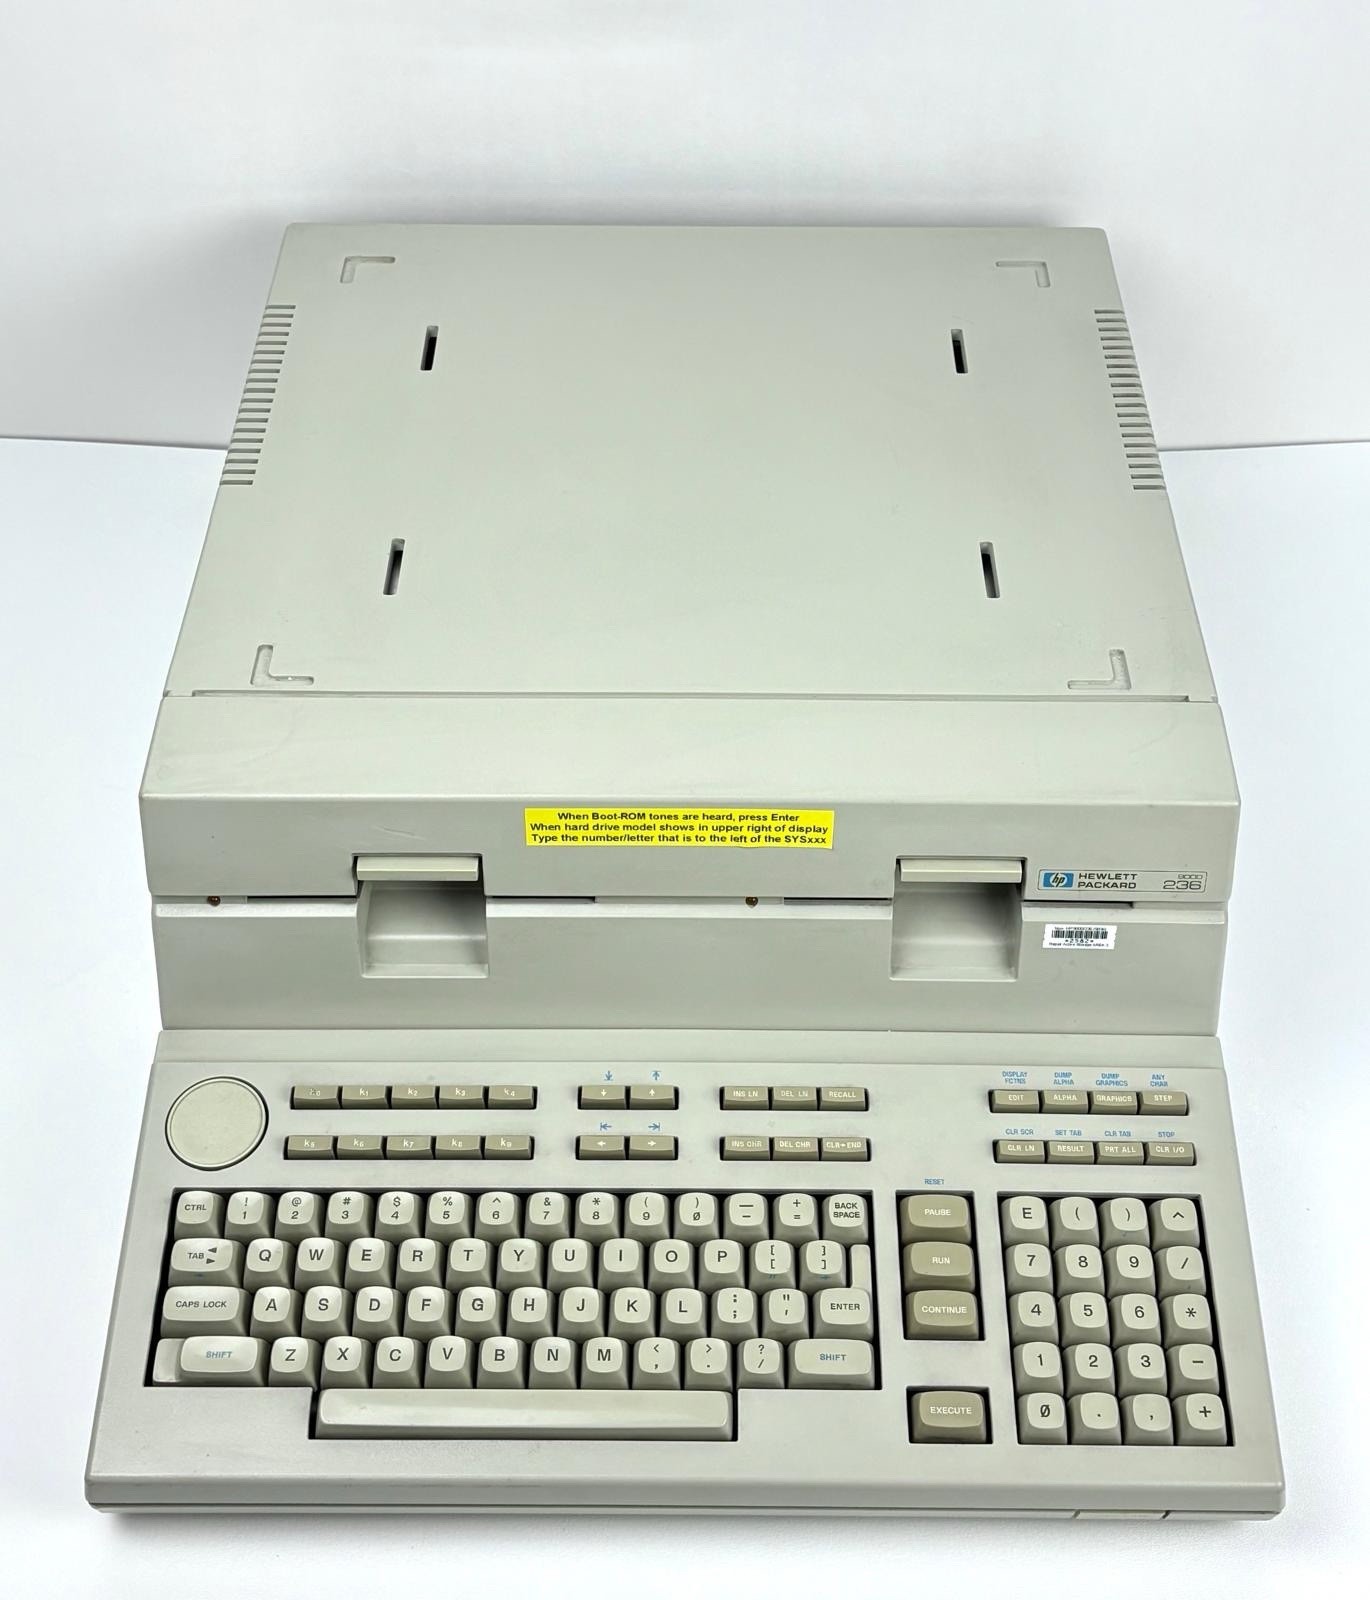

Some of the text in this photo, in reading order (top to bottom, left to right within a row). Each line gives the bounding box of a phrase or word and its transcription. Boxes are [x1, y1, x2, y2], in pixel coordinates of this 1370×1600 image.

[702, 813, 735, 821] heard,
[530, 823, 560, 831] When
[565, 823, 589, 831] hard
[592, 823, 620, 831] drive
[747, 824, 772, 833] right
[789, 825, 828, 834] display
[532, 834, 558, 843] Type
[582, 834, 654, 842] number/letter
[658, 834, 679, 842] that
[730, 835, 746, 843] left
[751, 835, 760, 843] of
[765, 835, 780, 843] the
[785, 835, 826, 843] SYSxxx
[1052, 873, 1065, 887] hp
[1078, 881, 1137, 889] PACKARD
[1163, 881, 1201, 890] 236
[292, 1197, 301, 1207] @
[343, 1197, 351, 1205] #
[393, 1196, 400, 1207] $
[443, 1197, 452, 1206] %
[544, 1197, 551, 1206] &
[243, 1211, 246, 1219] 1
[291, 1211, 299, 1219] 2
[342, 1210, 349, 1219] 3
[391, 1211, 398, 1219] 4
[443, 1211, 450, 1219] 5
[492, 1211, 499, 1219] 6
[544, 1211, 550, 1219] 7
[592, 1211, 599, 1219] 8
[643, 1212, 650, 1220] 9
[1022, 1208, 1032, 1219] E
[188, 1252, 204, 1260] TAB
[259, 1249, 271, 1262] Q
[309, 1249, 324, 1260] W
[361, 1249, 372, 1261] E
[412, 1250, 423, 1261] R
[464, 1250, 473, 1261] T
[514, 1250, 524, 1261] Y
[565, 1249, 575, 1261] U
[619, 1250, 622, 1261] I
[666, 1250, 678, 1262] O
[718, 1251, 727, 1262] P
[1027, 1255, 1036, 1266] 7
[1079, 1256, 1088, 1267] 8
[1129, 1256, 1139, 1268] 9
[265, 1299, 277, 1311] A
[318, 1298, 328, 1311] S
[369, 1298, 380, 1311] D
[422, 1299, 431, 1311] F
[472, 1298, 483, 1311] G
[524, 1298, 534, 1311] H
[577, 1299, 584, 1311] J
[627, 1300, 637, 1312] K
[679, 1301, 687, 1312] L
[1031, 1304, 1041, 1315] 4
[1084, 1305, 1093, 1316] 5
[1135, 1306, 1144, 1318] 6
[206, 1351, 232, 1360] SHIFT
[285, 1349, 296, 1361] Z
[337, 1348, 349, 1360] X
[390, 1349, 401, 1361] C
[443, 1348, 453, 1360] V
[495, 1349, 505, 1361] B
[548, 1349, 558, 1361] N
[598, 1349, 611, 1361] M
[1038, 1354, 1043, 1366] 1
[1089, 1355, 1098, 1367] 2
[1141, 1355, 1151, 1367] 3
